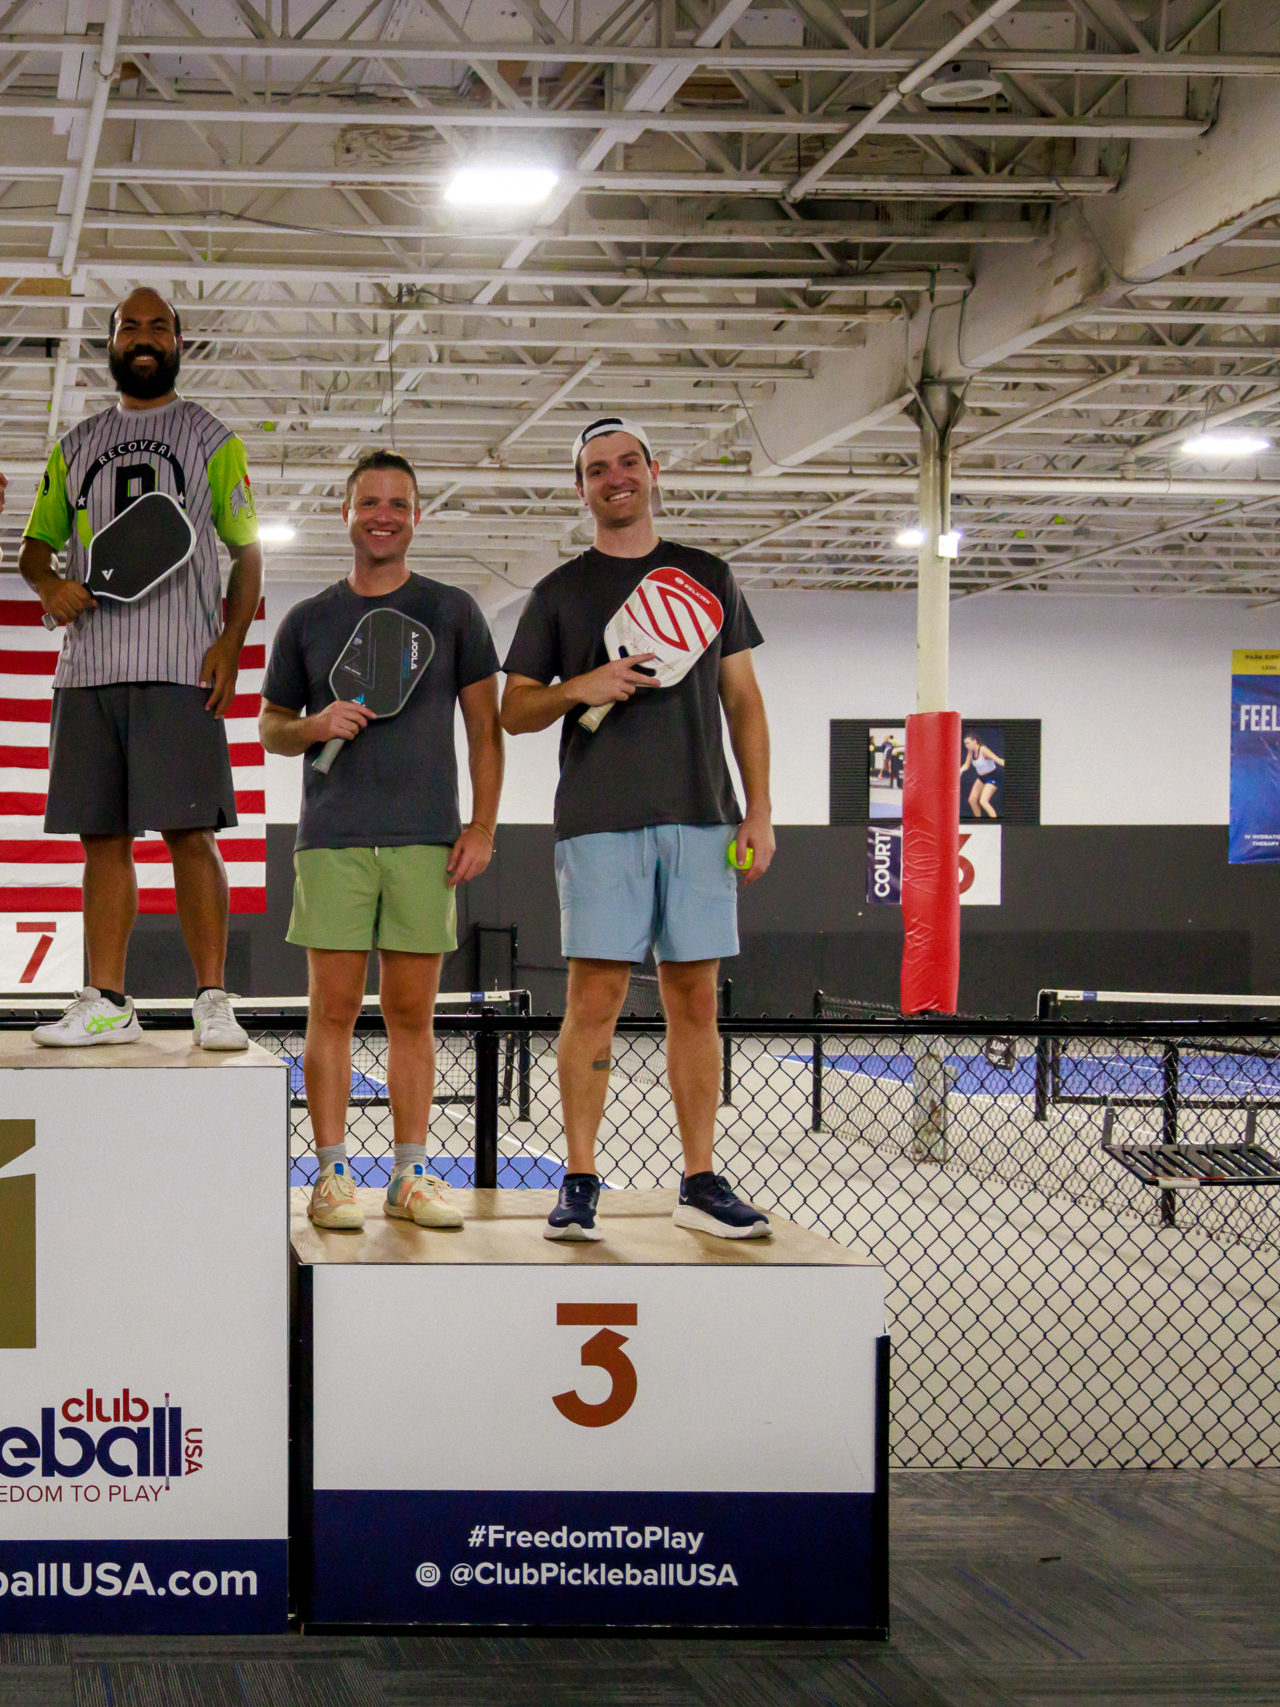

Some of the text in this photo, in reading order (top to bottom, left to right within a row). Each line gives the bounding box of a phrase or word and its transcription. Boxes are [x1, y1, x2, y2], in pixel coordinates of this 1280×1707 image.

[411, 640, 419, 670] JOOLA
[1240, 704, 1280, 732] FEEL
[874, 832, 891, 897] COURT
[16, 922, 56, 983] 7
[552, 1303, 638, 1428] 3
[61, 1388, 149, 1422] club
[184, 1428, 203, 1476] USA
[70, 1485, 101, 1503] TO
[108, 1484, 164, 1502] PLAY
[468, 1525, 705, 1555] #FreedomToPlay
[450, 1562, 739, 1588] @ClubPickleballUSA
